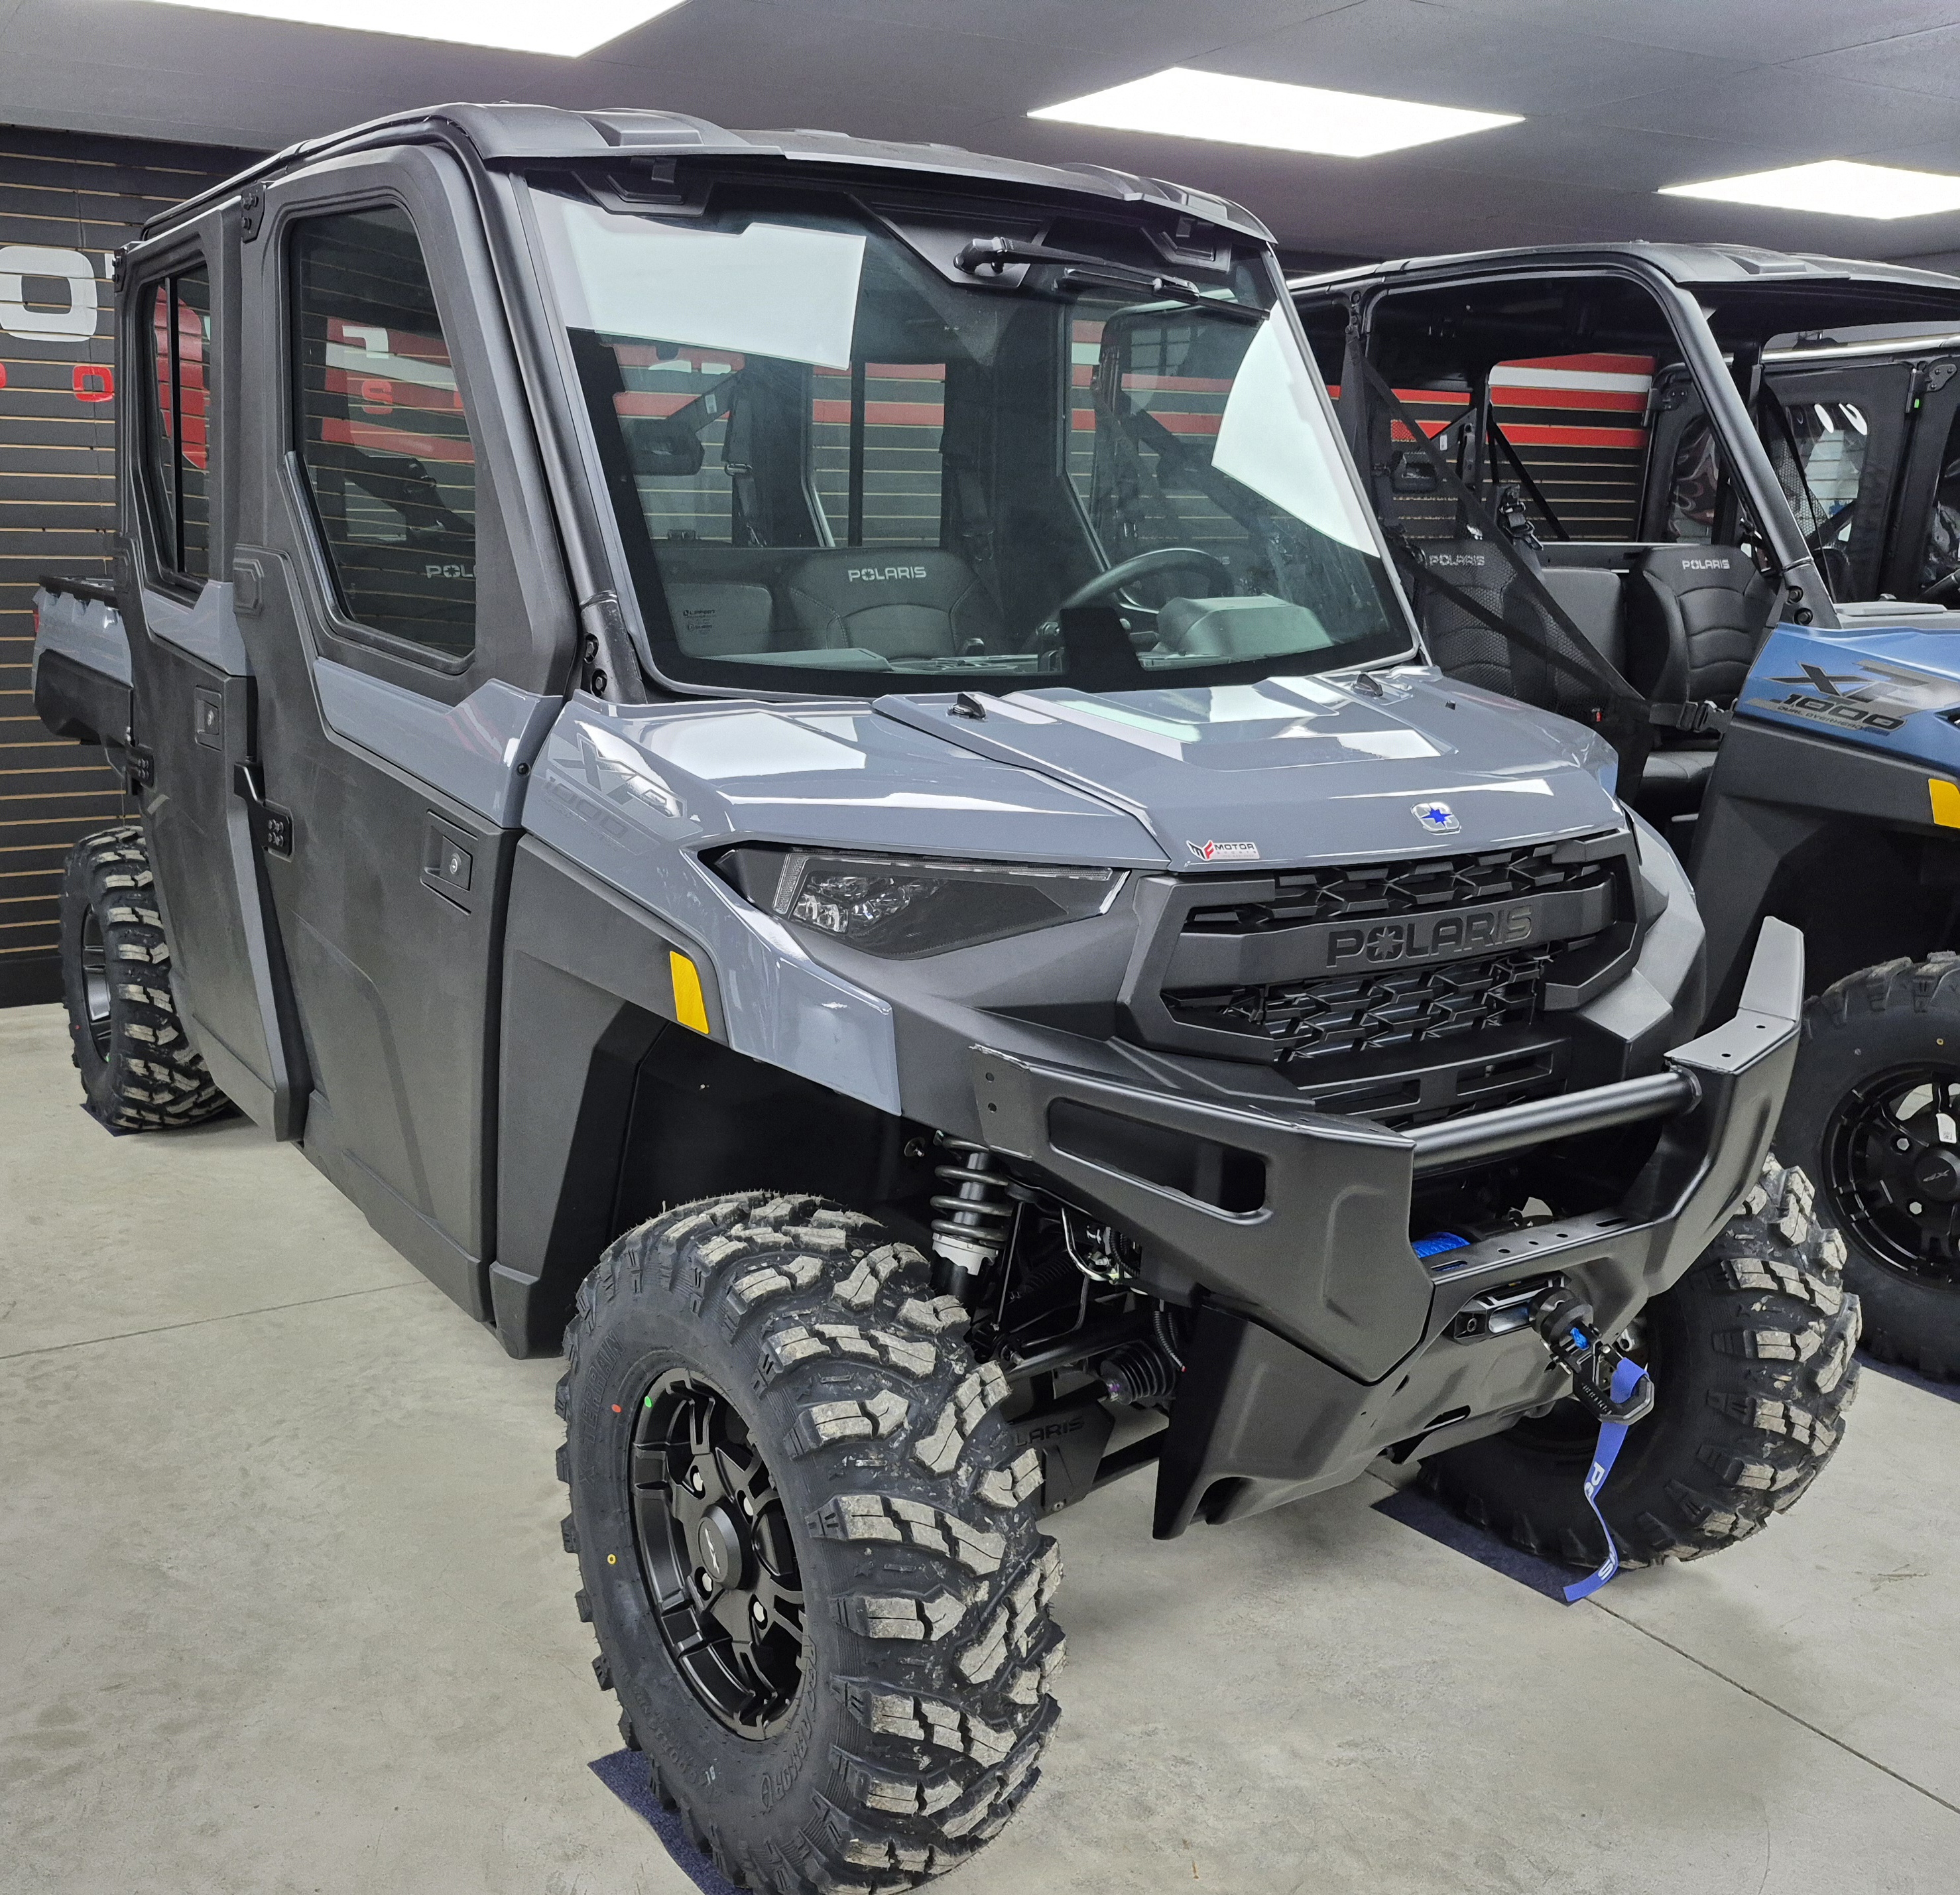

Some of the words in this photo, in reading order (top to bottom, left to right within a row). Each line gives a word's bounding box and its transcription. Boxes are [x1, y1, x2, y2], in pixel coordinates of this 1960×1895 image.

[1429, 554, 1485, 566] POLARIS
[1682, 559, 1731, 570] POLARIS
[425, 564, 477, 579] POL
[847, 566, 927, 582] POLARIS
[1781, 694, 1908, 731] 1000
[1326, 905, 1532, 968] POLARIS
[1016, 1416, 1085, 1447] LARIS
